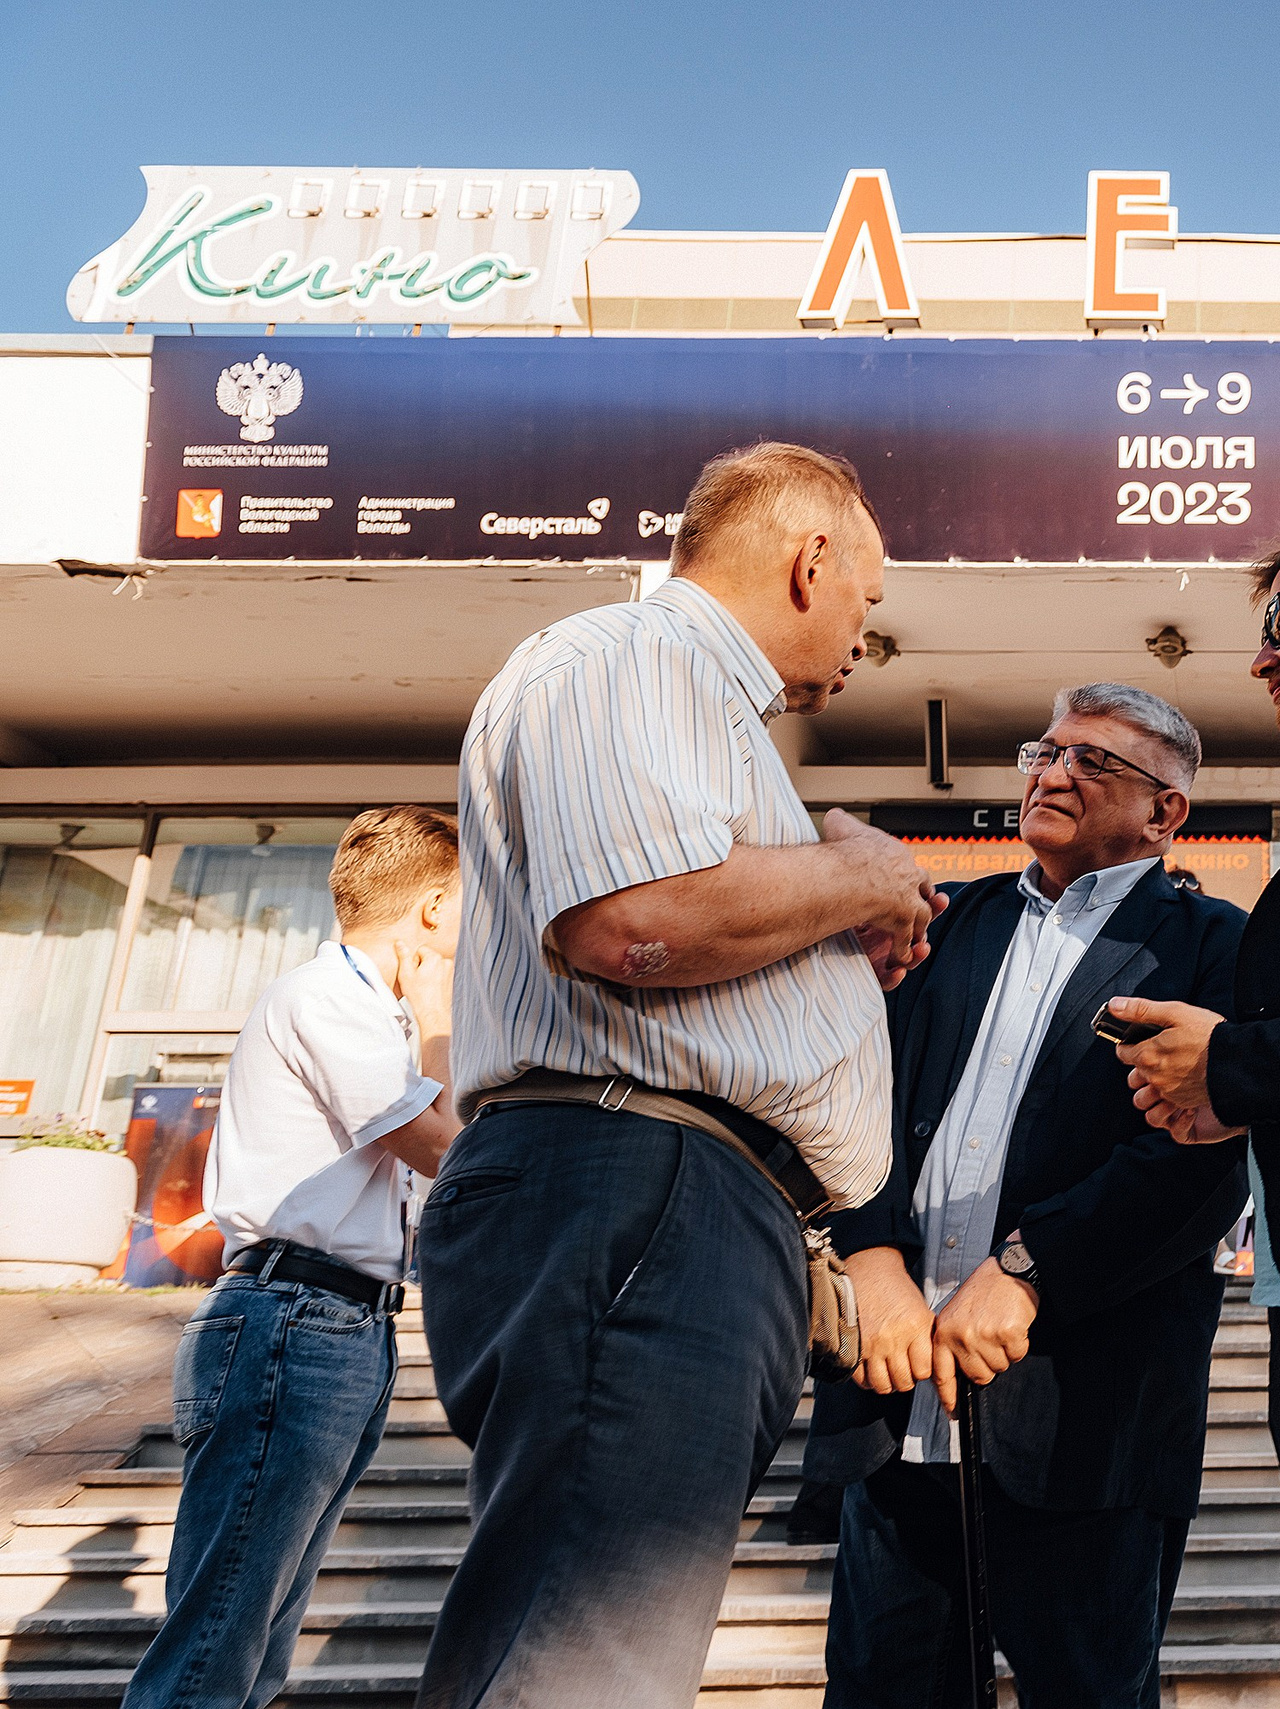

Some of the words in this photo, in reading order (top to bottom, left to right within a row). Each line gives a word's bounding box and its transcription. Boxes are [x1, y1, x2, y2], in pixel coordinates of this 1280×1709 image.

[111, 187, 536, 308] Кино
[1116, 481, 1252, 525] 2023
[480, 512, 603, 540] Северсталь
